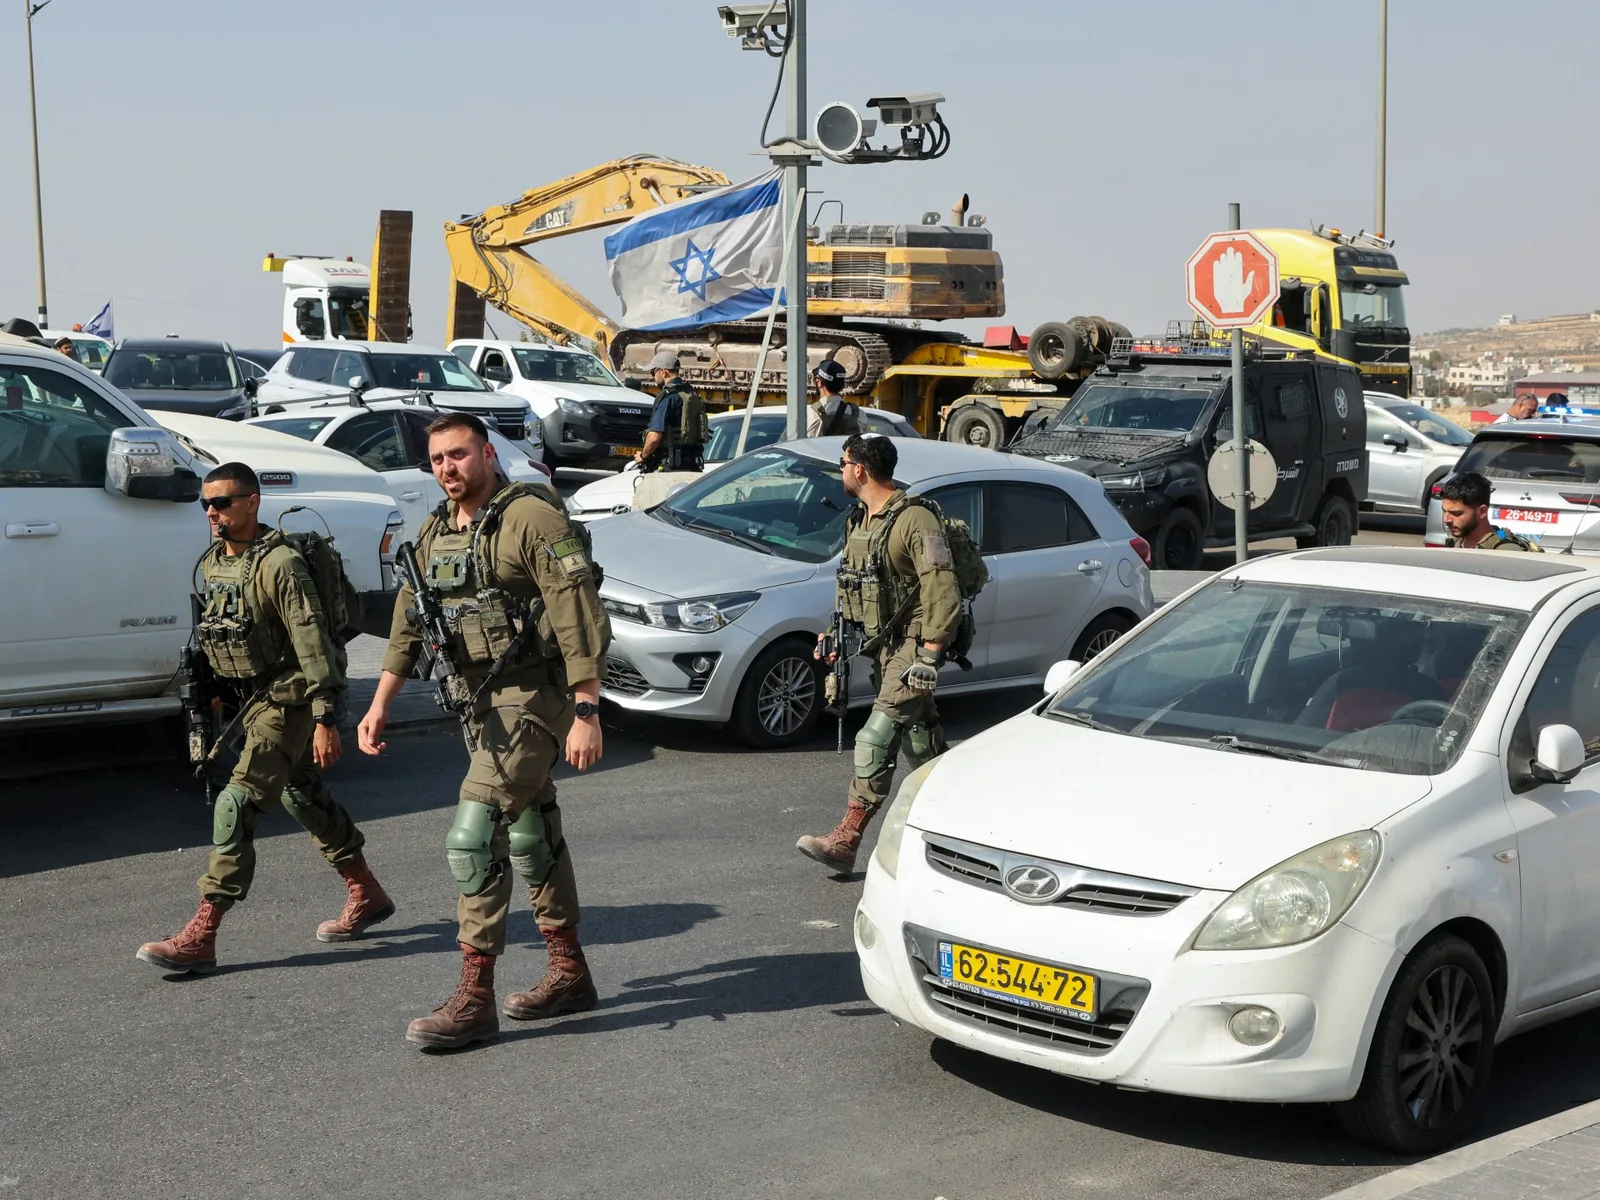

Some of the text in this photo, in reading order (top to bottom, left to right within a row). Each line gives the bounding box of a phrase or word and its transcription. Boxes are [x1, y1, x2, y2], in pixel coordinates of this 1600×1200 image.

[545, 210, 565, 228] CAT
[1336, 459, 1360, 472] משטרה
[119, 615, 178, 628] RAM
